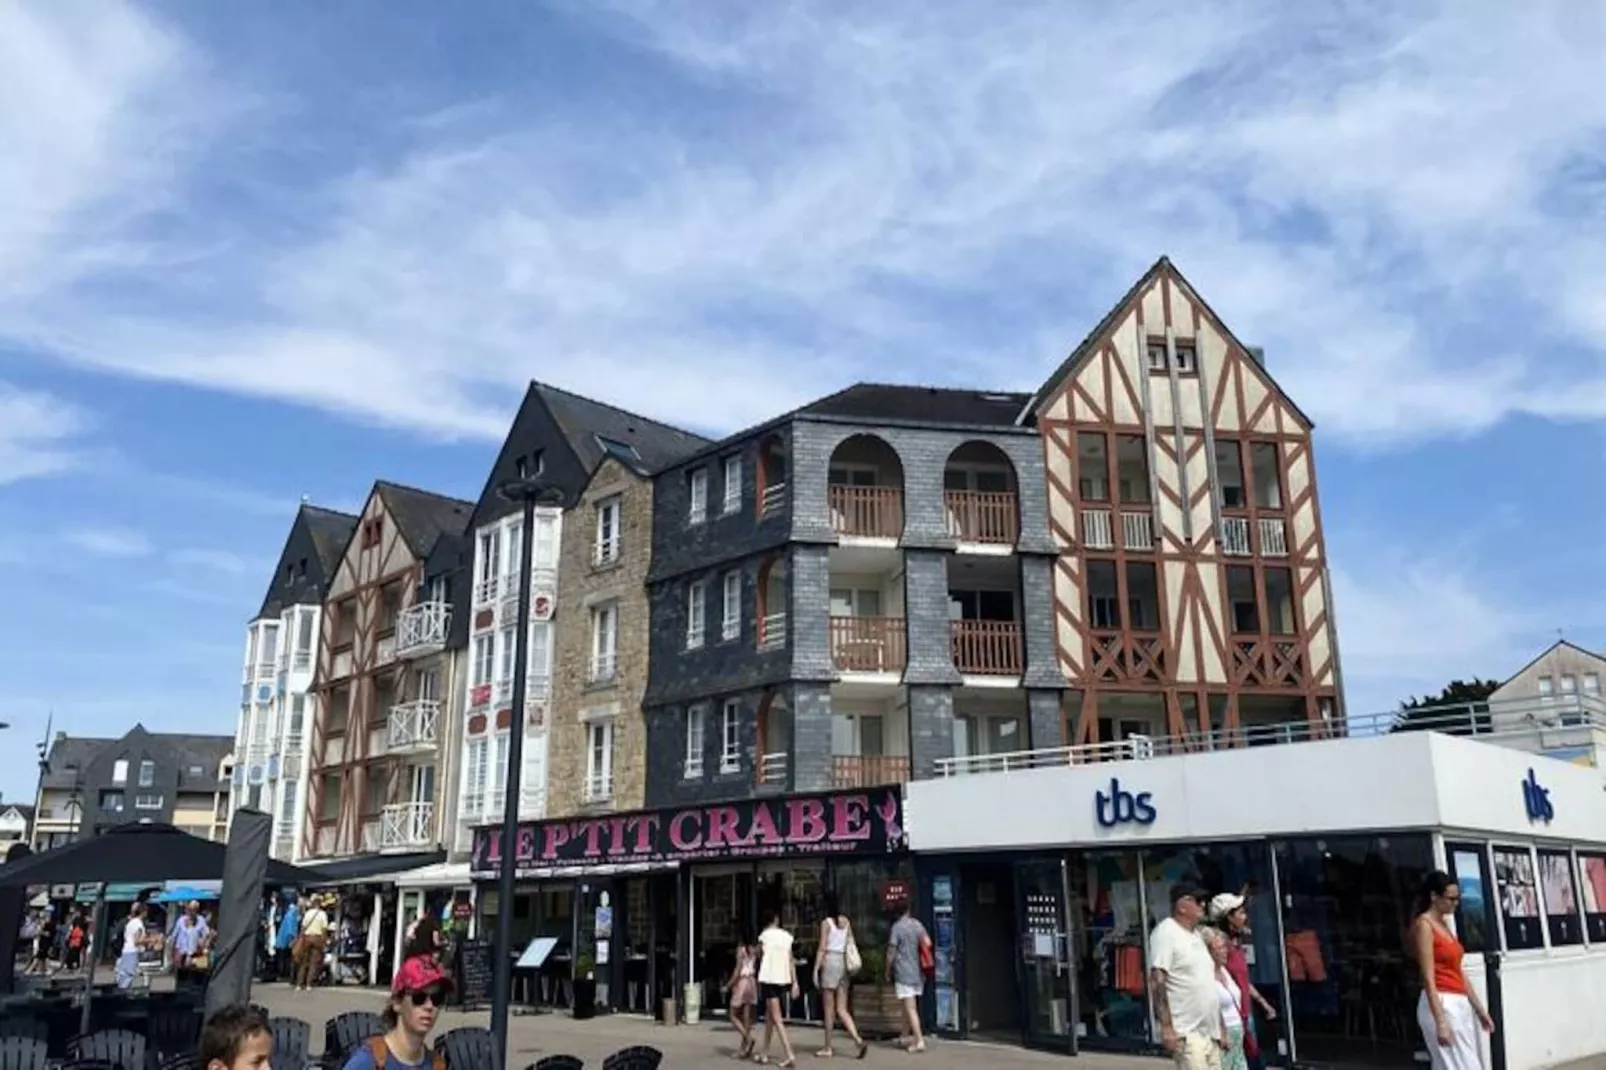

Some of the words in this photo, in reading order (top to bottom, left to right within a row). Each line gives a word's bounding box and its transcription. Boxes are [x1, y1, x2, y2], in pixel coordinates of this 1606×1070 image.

[1096, 778, 1156, 826] tbs
[542, 813, 661, 859] P'TIT
[668, 794, 871, 850] CRABE
[796, 841, 858, 853] Traiteur
